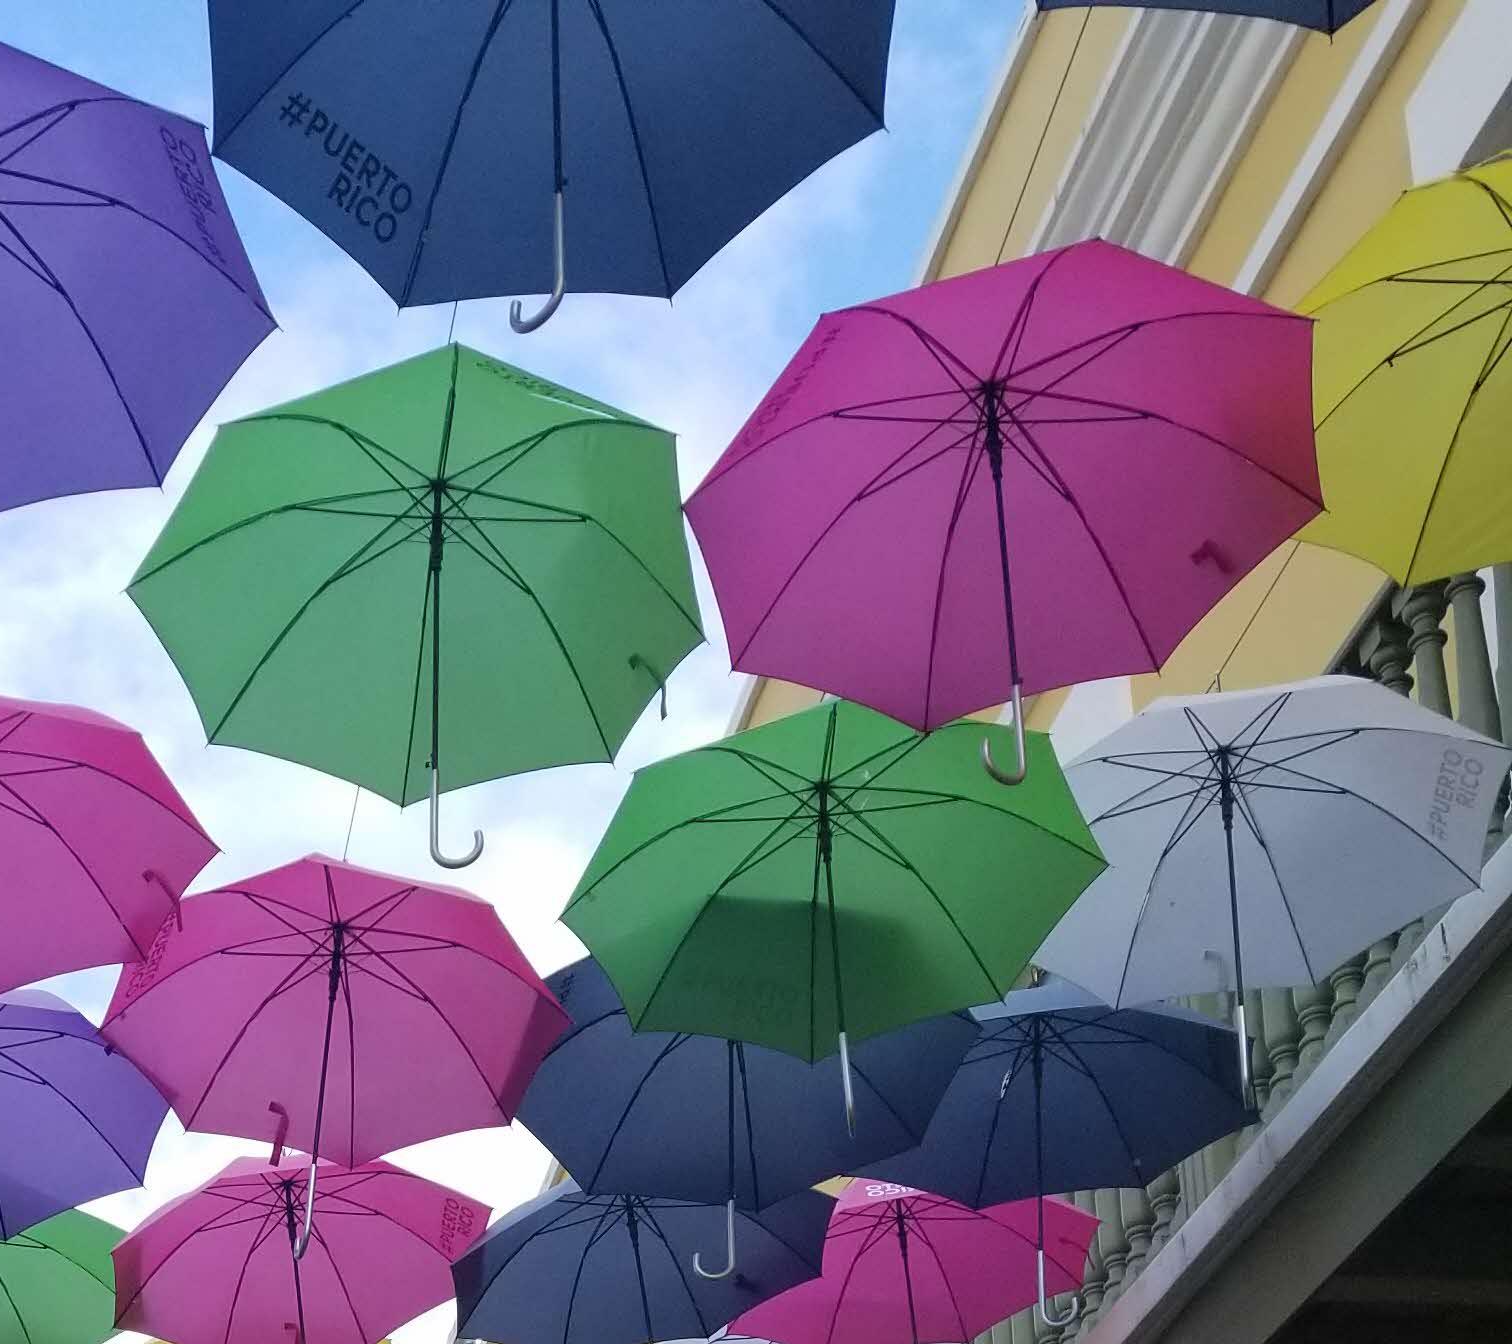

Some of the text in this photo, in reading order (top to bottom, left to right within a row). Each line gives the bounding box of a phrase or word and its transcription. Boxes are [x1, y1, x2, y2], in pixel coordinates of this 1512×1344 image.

[280, 91, 413, 213] #PUERTO
[329, 176, 397, 240] RICO
[1429, 747, 1464, 841] #PUERTO
[1455, 758, 1483, 807] RICO
[457, 1206, 475, 1238] RICO
